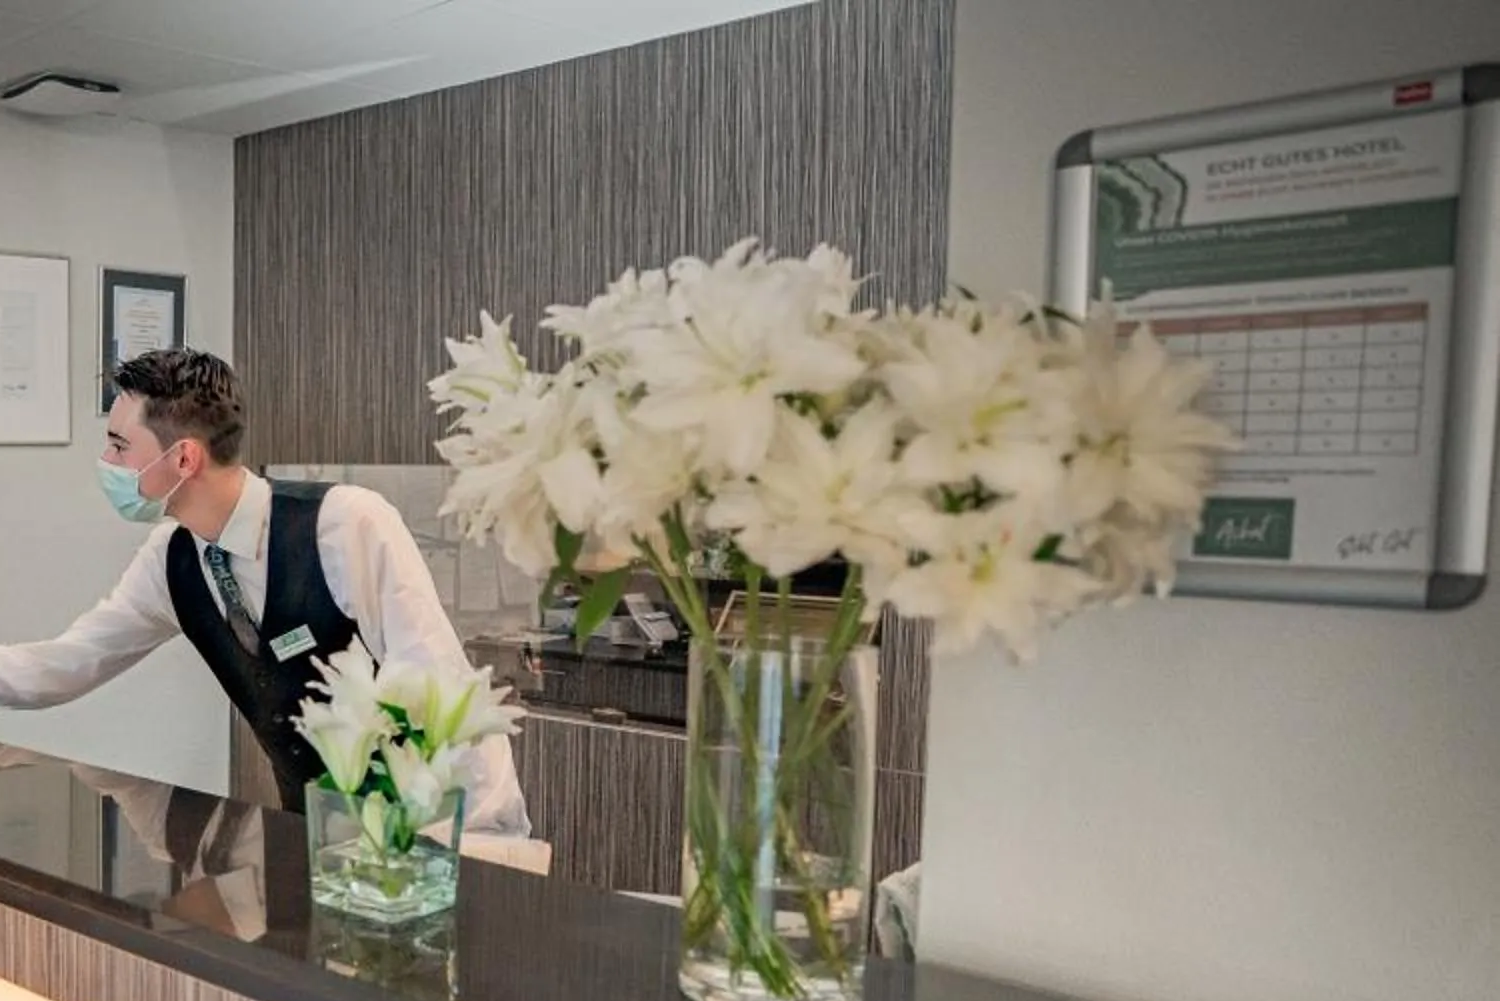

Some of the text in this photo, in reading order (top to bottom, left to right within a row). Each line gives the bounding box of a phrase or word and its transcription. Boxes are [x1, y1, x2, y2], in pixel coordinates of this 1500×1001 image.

[1206, 136, 1406, 177] ECHT GUTES HOTEL
